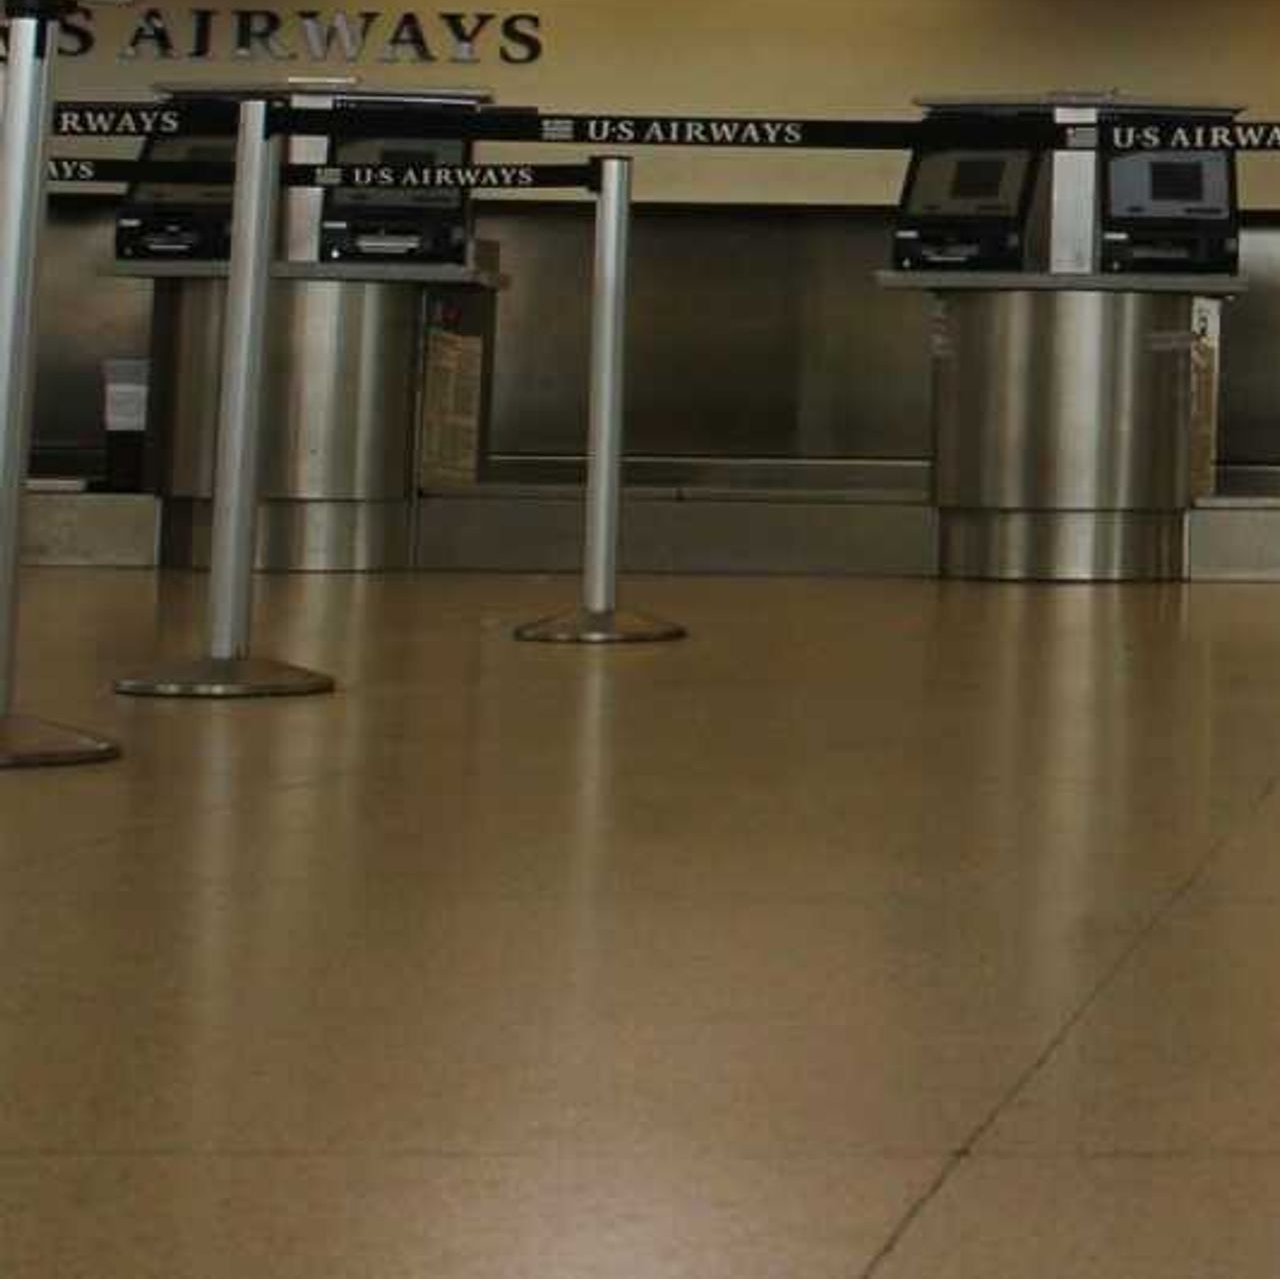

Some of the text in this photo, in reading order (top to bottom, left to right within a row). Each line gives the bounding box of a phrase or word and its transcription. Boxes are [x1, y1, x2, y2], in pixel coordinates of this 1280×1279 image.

[117, 7, 544, 66] AIRWAYS
[59, 109, 181, 134] RWAYS
[644, 121, 802, 144] AIRWAYS
[401, 167, 535, 186] AIRWAYS
